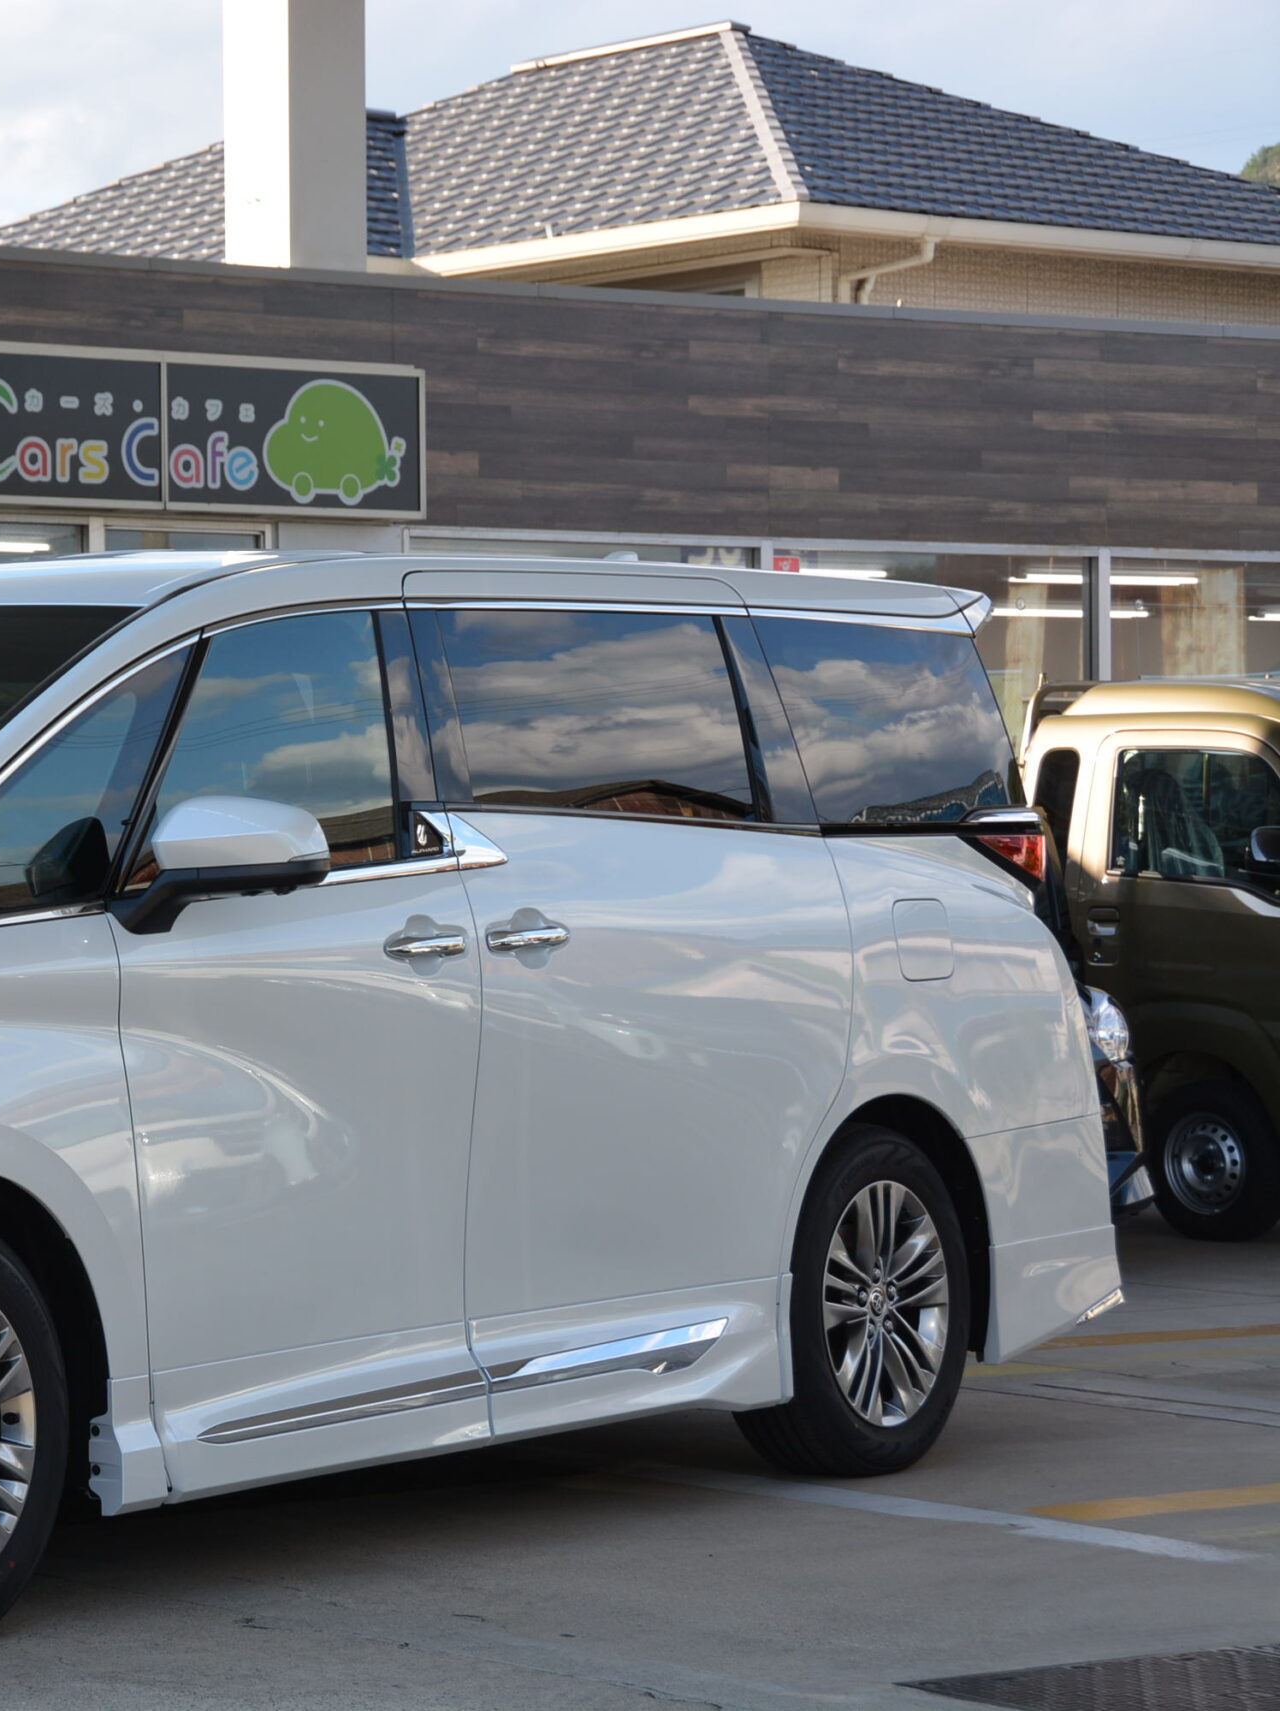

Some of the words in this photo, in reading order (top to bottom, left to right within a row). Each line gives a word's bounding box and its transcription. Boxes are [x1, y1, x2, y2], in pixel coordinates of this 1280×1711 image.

[24, 388, 256, 423] カーズ・カフェ
[121, 416, 259, 492] Cafe
